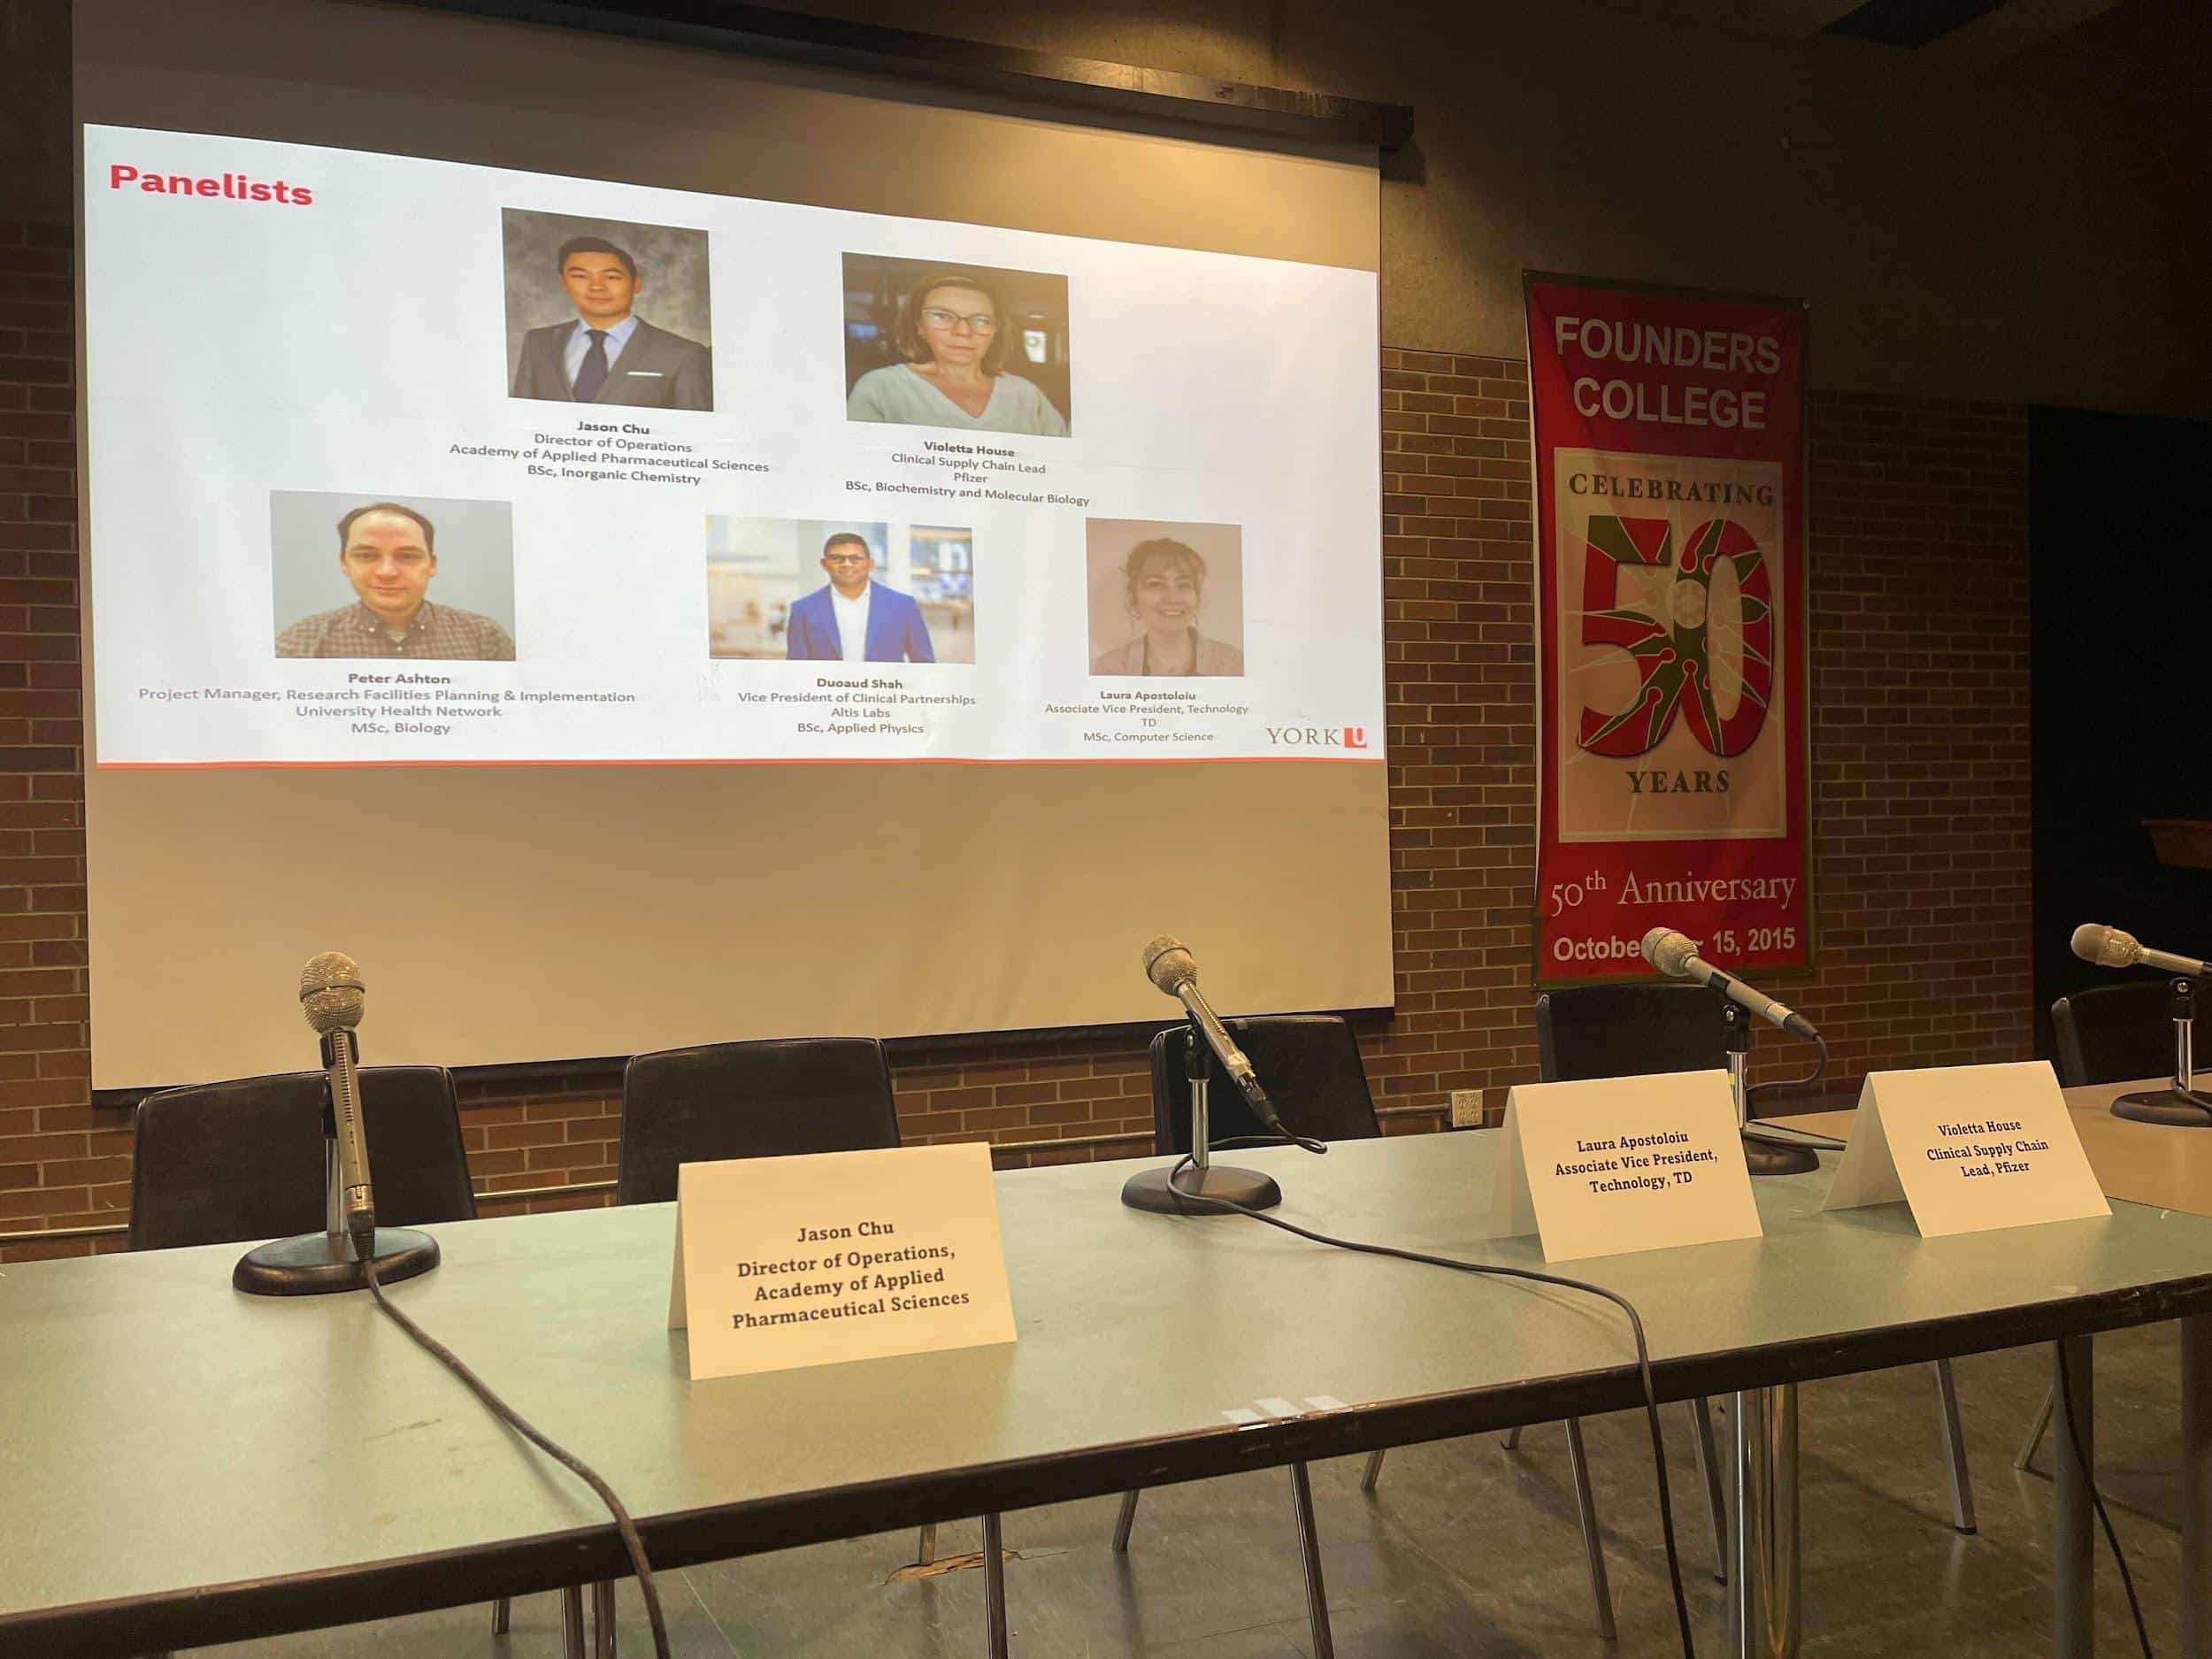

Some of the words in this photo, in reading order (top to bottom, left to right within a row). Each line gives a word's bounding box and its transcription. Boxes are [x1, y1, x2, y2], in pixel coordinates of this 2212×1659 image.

[110, 165, 312, 205] Panelists
[1555, 316, 1781, 374] FOUNDERS
[1573, 377, 1765, 430] COLLEGE
[577, 421, 618, 434] Jason
[622, 424, 649, 434] Chu
[534, 434, 593, 448] Director
[597, 438, 613, 448] of
[616, 439, 692, 455] Operations
[925, 441, 973, 454] Violetta
[976, 445, 1015, 457] House
[449, 444, 518, 459] Academy
[523, 448, 538, 459] of
[541, 450, 597, 465] Applied
[602, 453, 709, 469] Pharmaceutical
[712, 459, 770, 472] Sciences
[892, 453, 935, 465] Clinical
[938, 457, 979, 471] Supply
[982, 460, 1015, 472] Chain
[1018, 464, 1046, 474] Lead
[527, 465, 557, 478] BSc,
[562, 466, 627, 483] Inorganic
[631, 471, 701, 486] Chemistry
[954, 472, 988, 484] Pfizer
[846, 480, 872, 493] BSc,
[876, 482, 956, 498] Biochemistry
[959, 487, 981, 498] and
[985, 489, 1044, 503] Molecular
[1048, 494, 1090, 508] Biology
[1569, 473, 1773, 506] CELEBRATING
[1577, 514, 1775, 758] 50
[348, 672, 390, 684] Peter
[396, 672, 451, 685] Ashton
[817, 679, 869, 689] Duoaud
[872, 680, 902, 689] Shah
[139, 687, 199, 702] Project
[204, 687, 282, 703] Manager,
[286, 687, 359, 702] Research
[364, 688, 430, 702] Facilities
[434, 689, 500, 704] Planning
[503, 690, 516, 703] &
[520, 690, 635, 705] Implementation
[738, 693, 766, 703] Vice
[771, 693, 833, 703] President
[835, 693, 849, 703] of
[852, 694, 896, 703] Clinical
[901, 694, 976, 706] Partnerships
[1101, 691, 1132, 701] Laura
[1134, 691, 1196, 703] Apostoloiu
[296, 705, 376, 719] University
[380, 705, 431, 718] Health
[436, 705, 503, 718] Network
[831, 708, 859, 718] Altis
[864, 708, 891, 718] Labs
[1045, 703, 1100, 714] Associate
[1102, 704, 1127, 714] Vice
[1130, 704, 1185, 715] President,
[1187, 704, 1248, 715] Technology
[351, 723, 390, 735] MSc,
[395, 722, 451, 735] Biology
[797, 723, 824, 734] BSc,
[827, 723, 876, 735] Applied
[879, 723, 924, 735] Physics
[1142, 718, 1156, 727] TD
[1084, 733, 1111, 743] MSc,
[1114, 732, 1170, 743] Computer
[1172, 732, 1214, 741] Science
[1266, 727, 1340, 745] YORK
[1625, 770, 1730, 794] YEARS
[1617, 871, 1797, 910] Anniversary
[1553, 935, 1642, 962] Octobe
[1712, 930, 1741, 956] 15,
[1747, 927, 1796, 952] 2015
[1938, 1123, 1985, 1137] Violetta
[1985, 1120, 2023, 1133] House
[1577, 1138, 1617, 1153] Laura
[1619, 1131, 1689, 1150] Apostoloiu
[1926, 1146, 1972, 1161] Clinical
[1974, 1142, 2013, 1157] Supply
[2016, 1140, 2049, 1152] Chain
[1555, 1159, 1618, 1176] Associate
[1621, 1156, 1650, 1169] Vice
[1653, 1148, 1718, 1166] President,
[1961, 1164, 1994, 1179] Lead,
[1994, 1162, 2030, 1175] Pfizer
[1589, 1174, 1671, 1194] Technology,
[1673, 1171, 1693, 1184] TD
[797, 1226, 852, 1242] Jason
[857, 1221, 895, 1237] Chu
[737, 1257, 818, 1278] Director
[823, 1254, 842, 1268] of
[847, 1245, 956, 1267] Operations,
[754, 1279, 842, 1302] Academy
[849, 1277, 869, 1292] of
[873, 1268, 945, 1291] Applied
[732, 1298, 885, 1329] Pharmaceutical
[891, 1293, 971, 1311] Sciences
